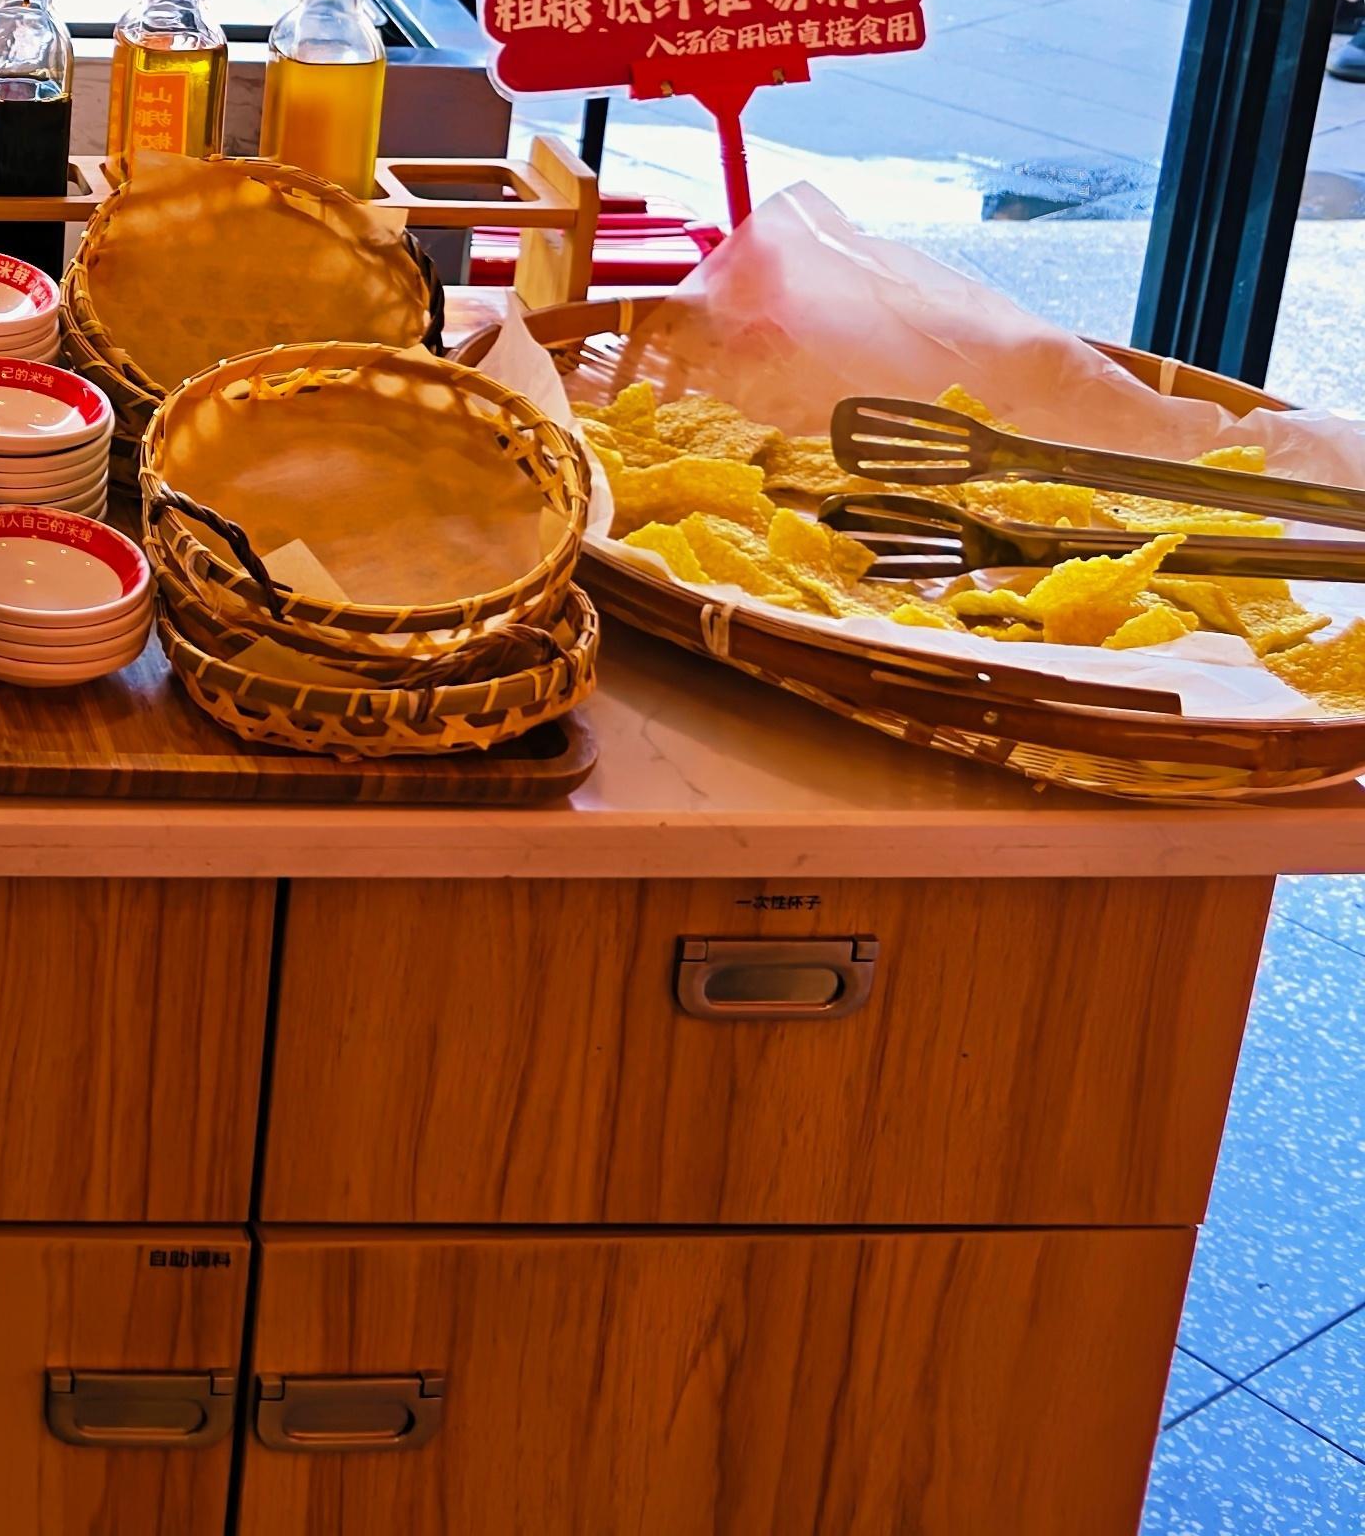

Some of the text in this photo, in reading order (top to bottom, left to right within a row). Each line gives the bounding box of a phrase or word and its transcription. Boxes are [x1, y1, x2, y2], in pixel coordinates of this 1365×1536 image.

[646, 12, 917, 58] 入汤食用或直接食用
[735, 895, 822, 911] 一次性杯子
[149, 1250, 232, 1268] 自助调料
